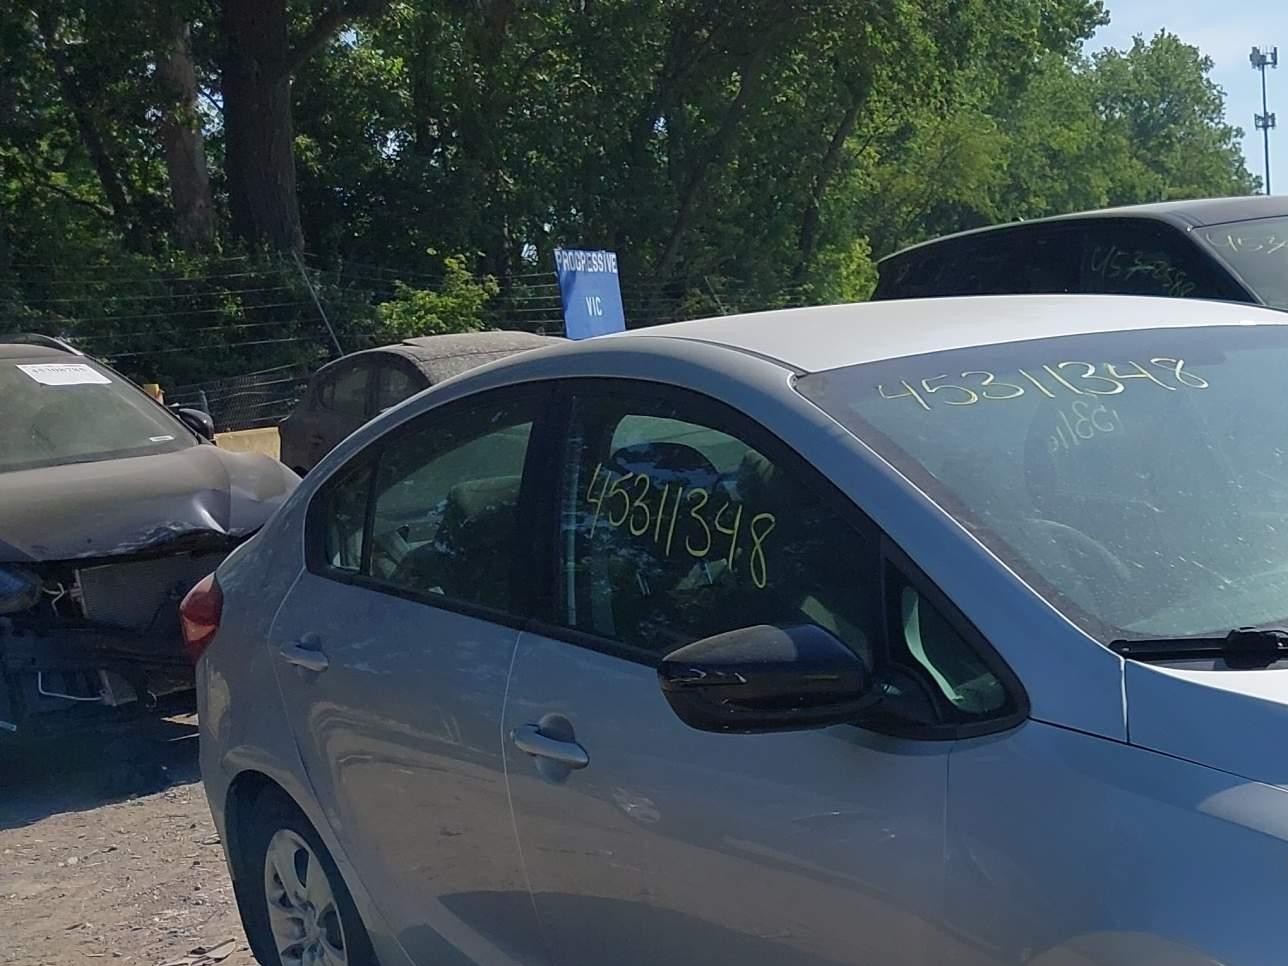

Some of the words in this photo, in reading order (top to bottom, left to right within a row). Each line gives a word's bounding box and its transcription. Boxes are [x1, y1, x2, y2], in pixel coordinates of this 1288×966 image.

[554, 249, 618, 273] PROGRESSIVE
[585, 296, 603, 316] VIC
[878, 357, 1208, 410] 45311348
[587, 463, 775, 588] 45311348
